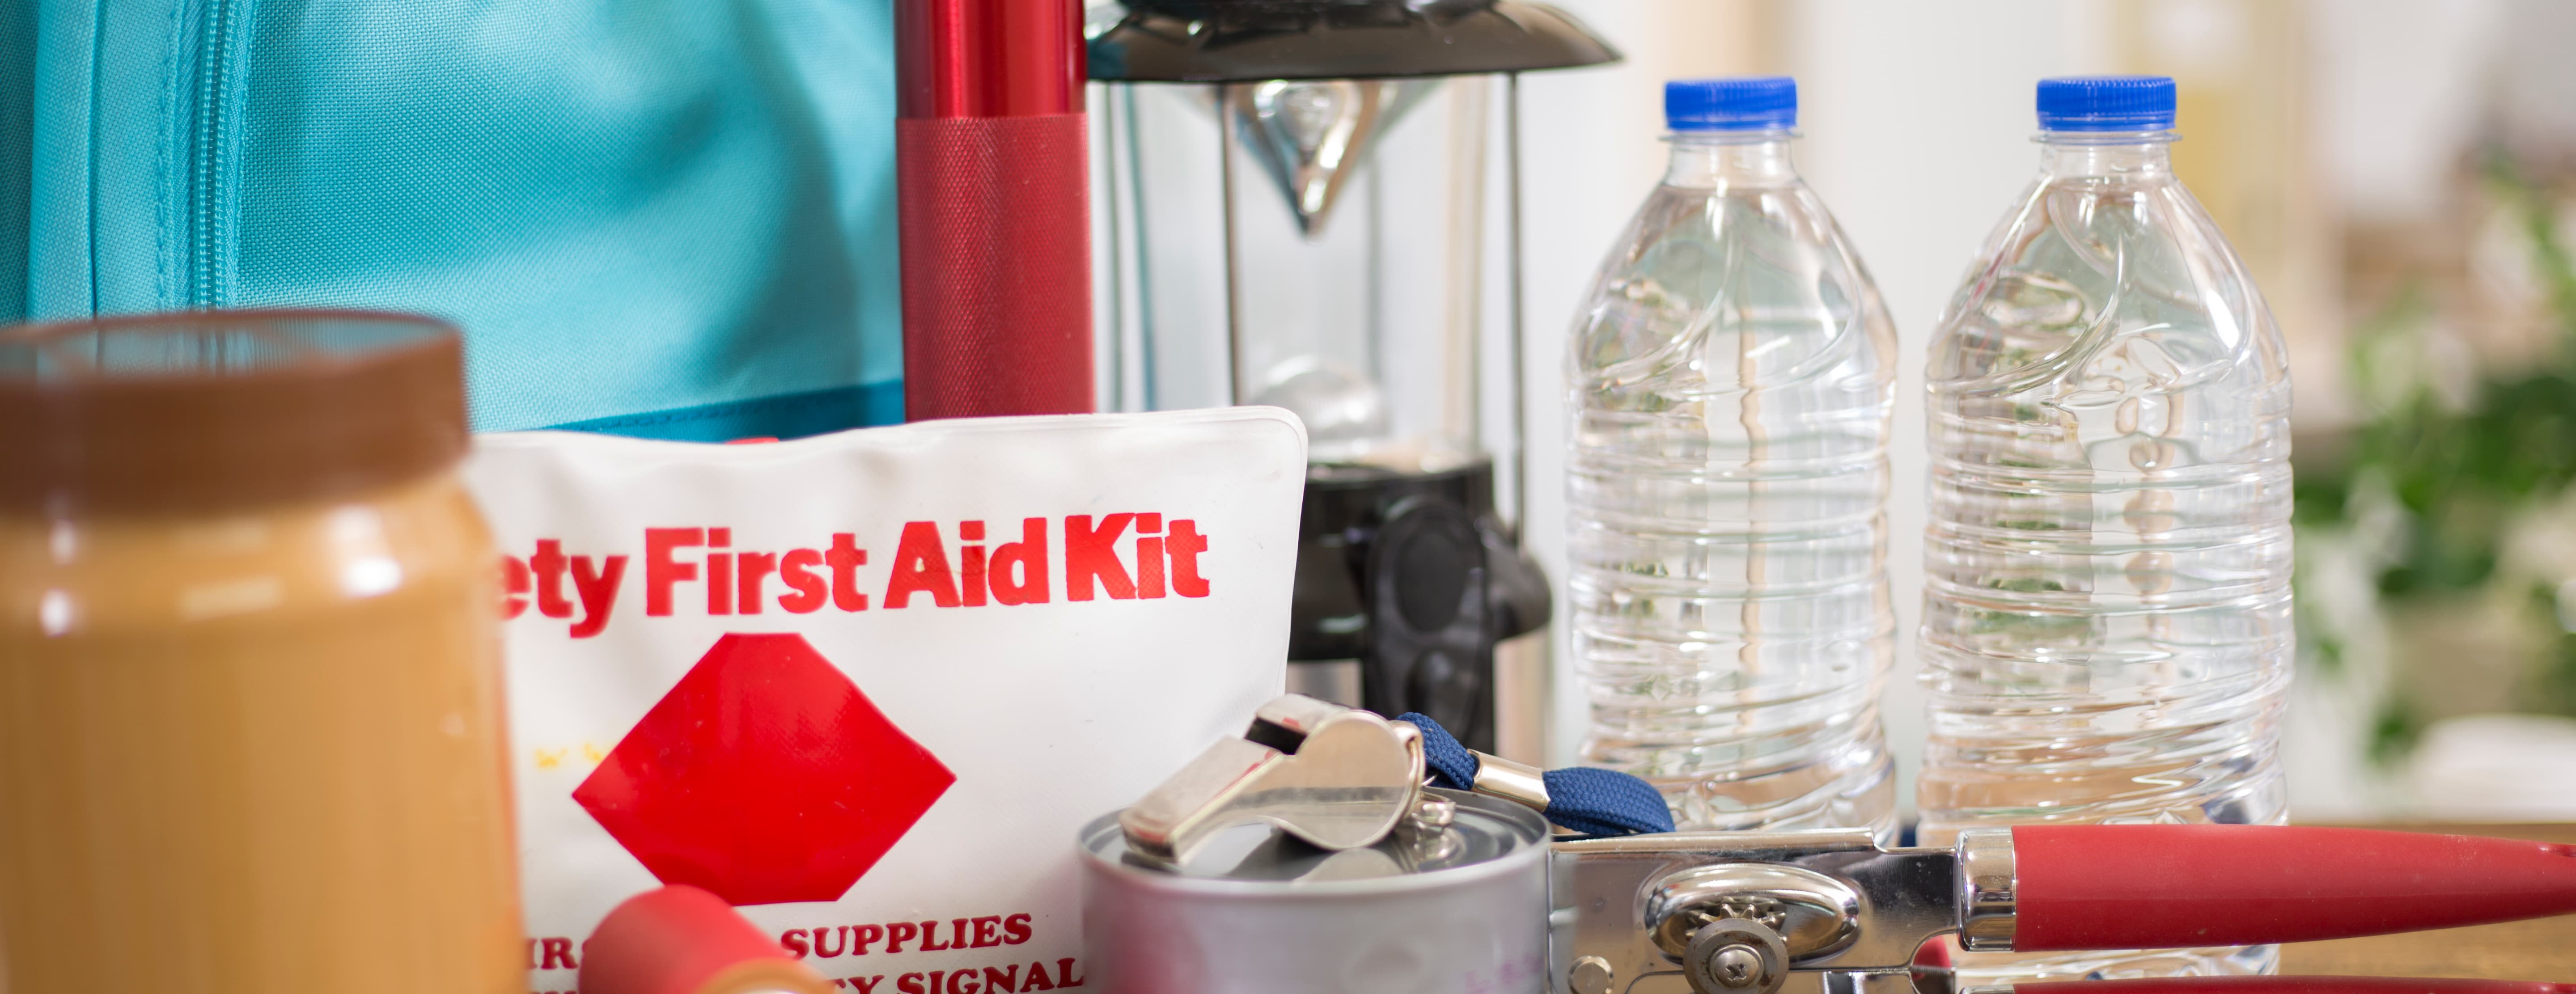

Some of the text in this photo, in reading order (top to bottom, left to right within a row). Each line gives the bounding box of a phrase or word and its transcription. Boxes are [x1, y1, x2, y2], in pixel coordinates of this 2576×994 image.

[644, 526, 869, 618] First
[882, 516, 1051, 610] Aid
[1064, 512, 1211, 602] Kit
[781, 913, 1032, 960] SUPPLIES
[897, 957, 1084, 994] SIGNAL
